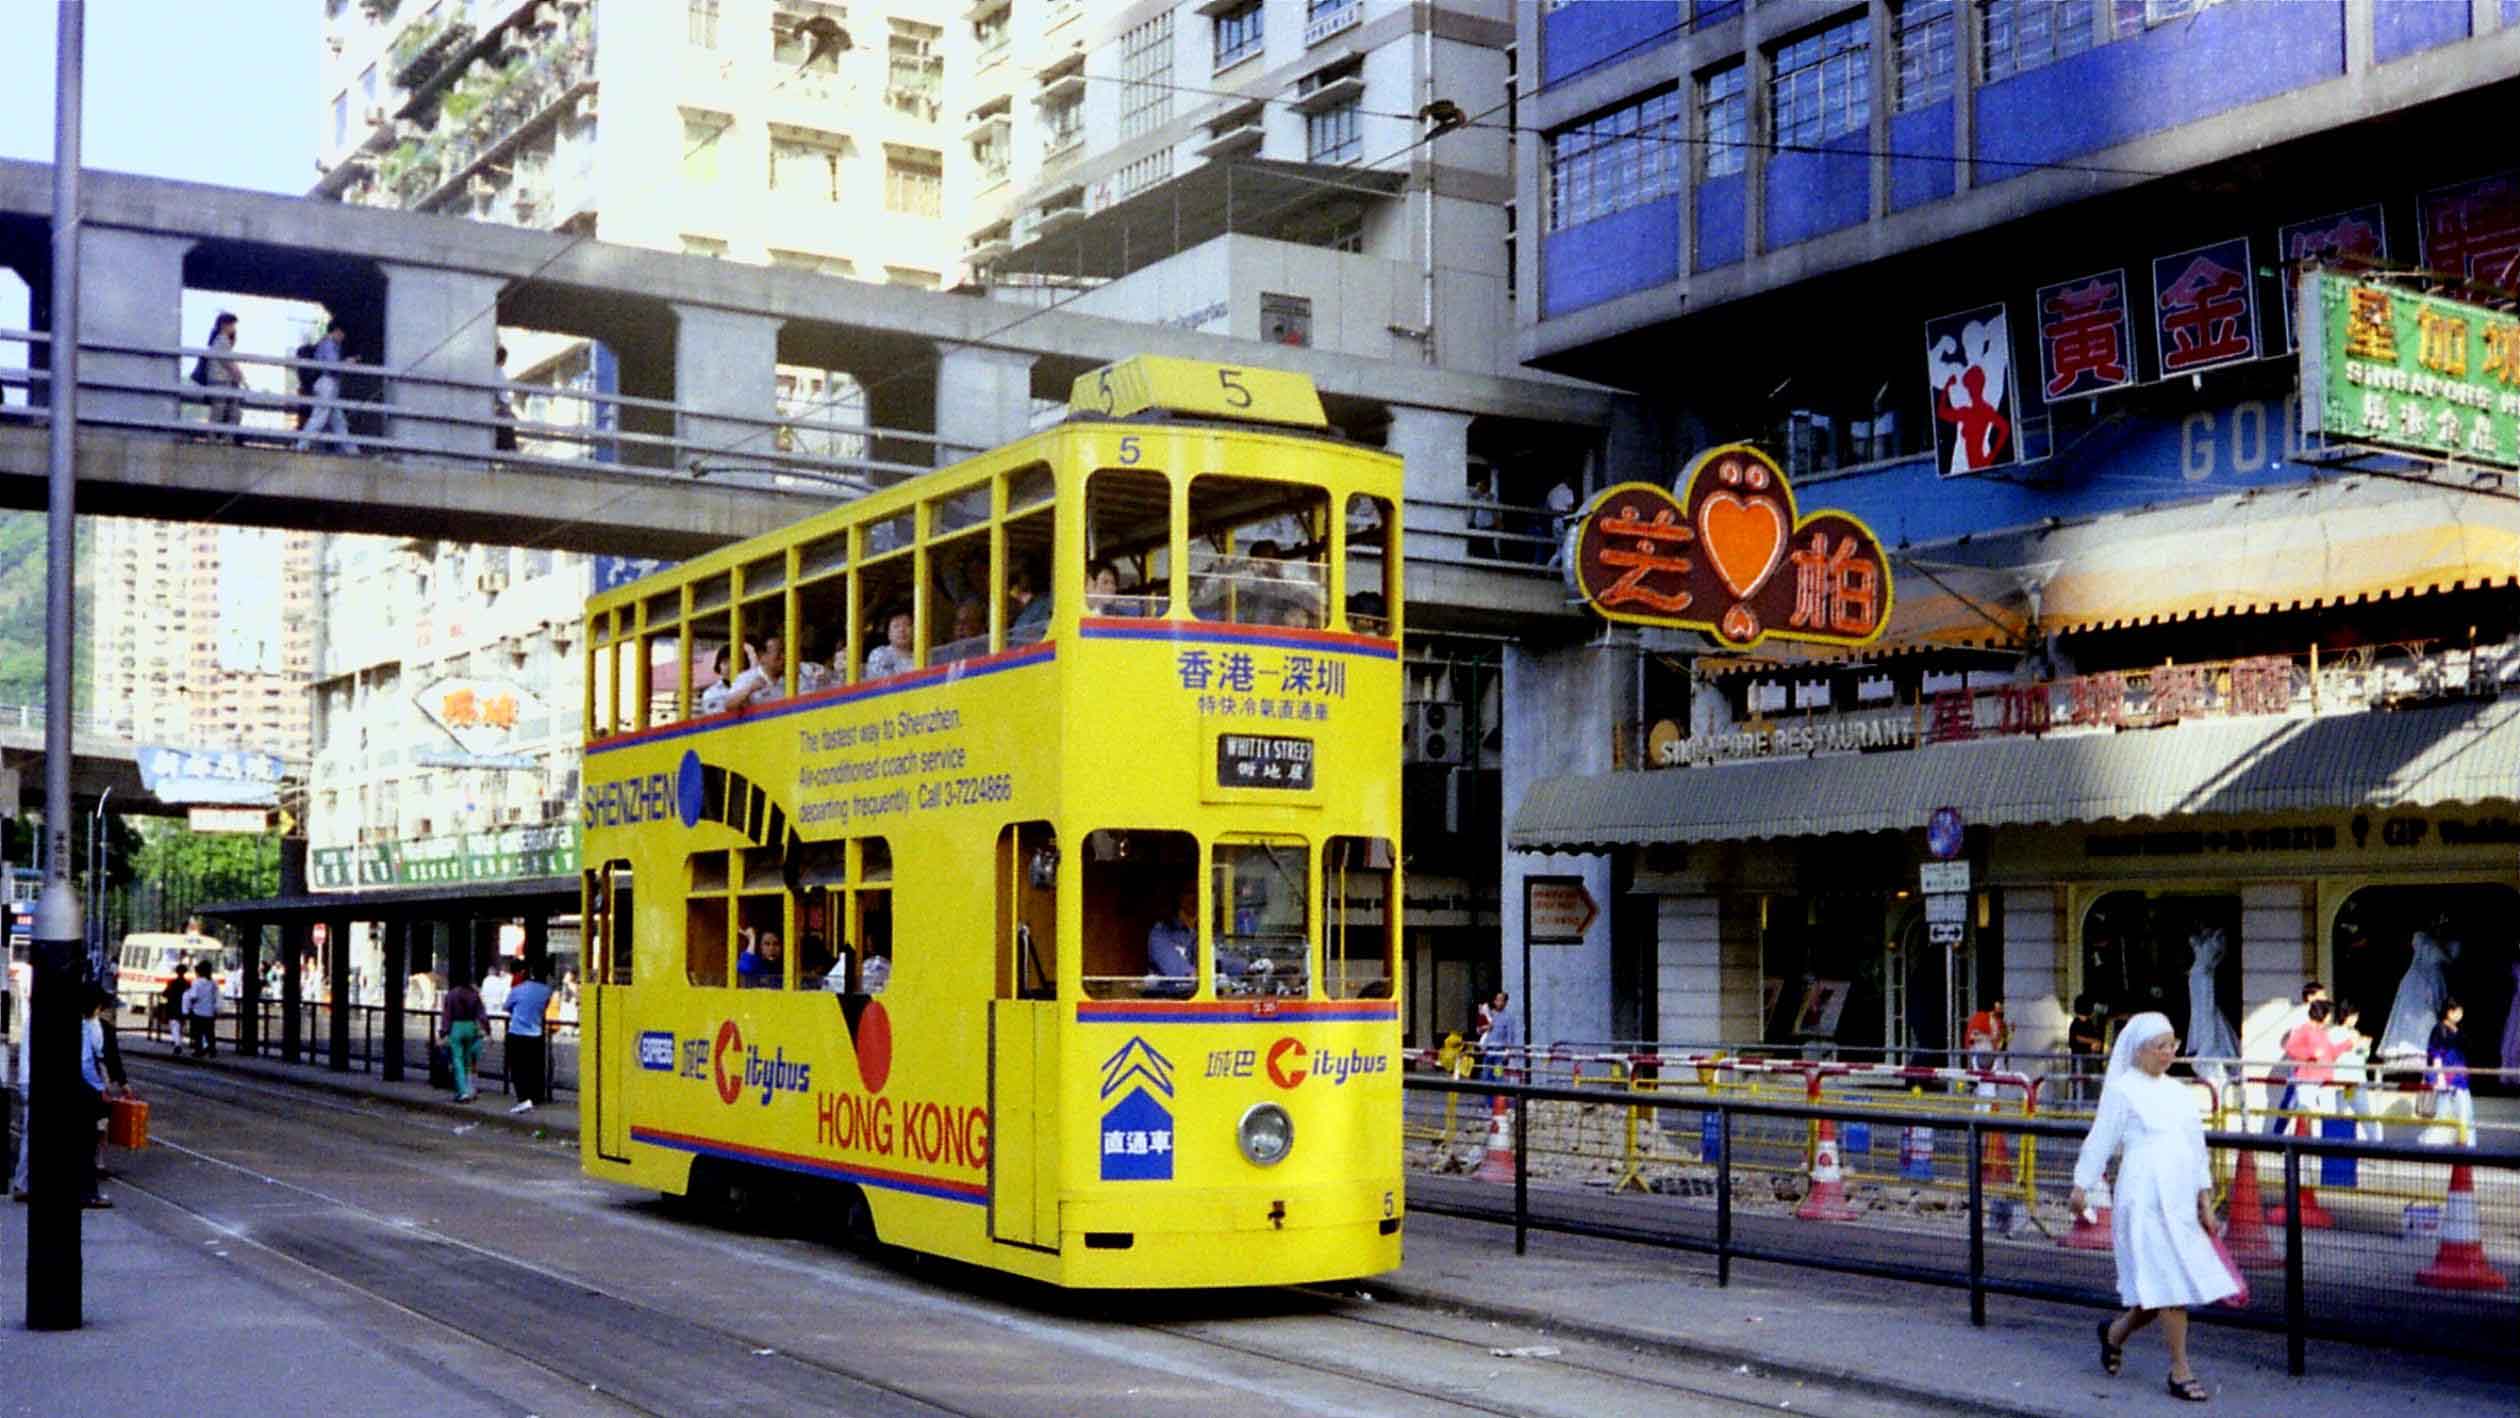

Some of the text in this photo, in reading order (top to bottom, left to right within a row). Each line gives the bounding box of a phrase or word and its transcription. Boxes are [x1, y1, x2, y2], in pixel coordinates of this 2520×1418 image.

[1218, 368, 1253, 408] 5
[2346, 360, 2491, 413] SINGAPORE
[1119, 436, 1141, 465] 5
[800, 729, 818, 752] The
[822, 726, 857, 750] fastest
[860, 723, 879, 747] way
[883, 718, 893, 740] to
[1227, 735, 1313, 762] WHITTY STREET
[1661, 716, 1912, 766] SINGAPORE RESTAURANT
[881, 750, 917, 777] coach
[921, 742, 965, 772] service
[584, 772, 676, 829] SHENZHEN
[799, 798, 848, 825] departing
[918, 780, 942, 810] Call
[714, 1019, 811, 1106] Citybus
[1266, 1036, 1387, 1090] Citybus
[817, 1090, 989, 1170] HONG KONG
[1103, 1129, 1172, 1156] 直通車
[1383, 1191, 1394, 1218] 5
